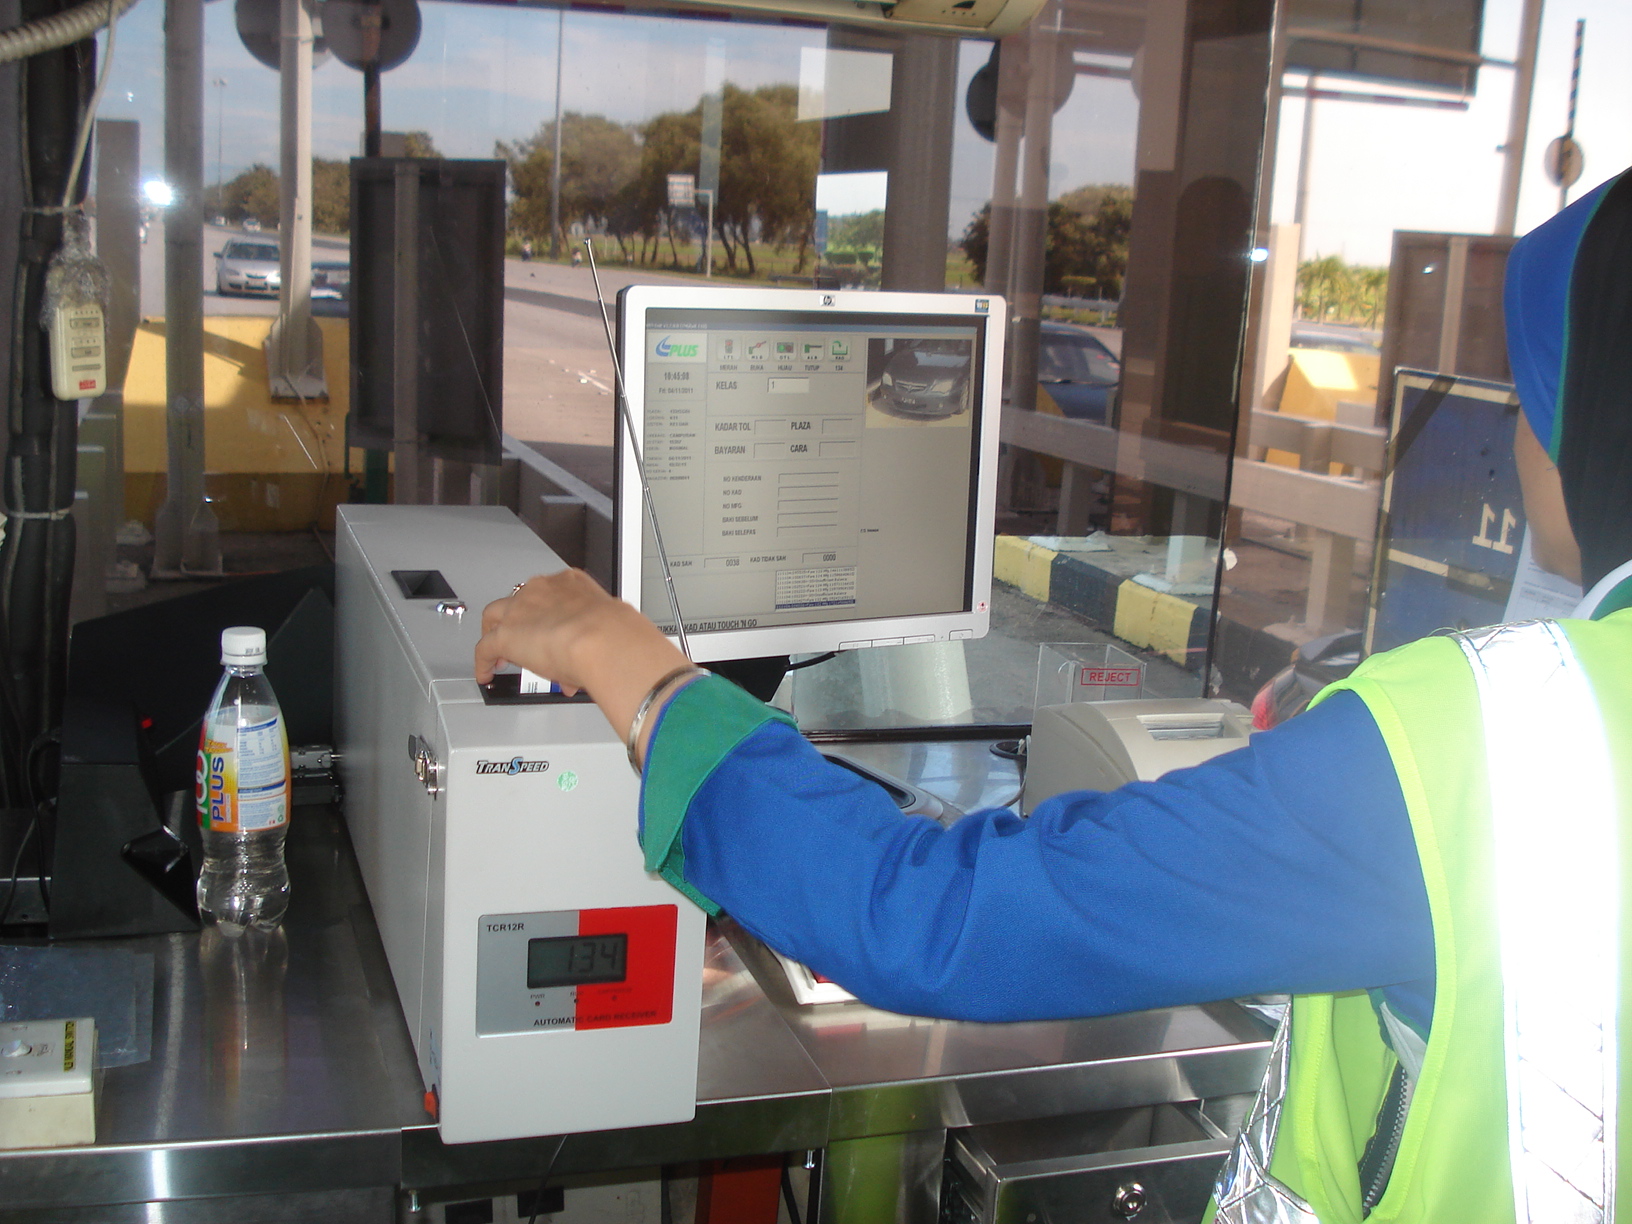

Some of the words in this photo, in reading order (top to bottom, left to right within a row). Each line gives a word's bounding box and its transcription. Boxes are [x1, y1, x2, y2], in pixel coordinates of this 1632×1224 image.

[669, 344, 698, 356] PLUS
[716, 381, 737, 390] KELAS
[715, 422, 738, 431] KADAR
[739, 422, 751, 431] TOL
[790, 421, 811, 431] PLAZA
[714, 445, 746, 455] BAYARAN
[790, 444, 808, 453] CARA
[684, 624, 698, 632] KAD
[699, 622, 717, 631] ATAU
[717, 620, 739, 629] TOUCH
[747, 619, 758, 627] GO
[1089, 671, 1132, 682] REJECT
[212, 756, 225, 822] PLUS
[486, 923, 525, 932] TCR12R
[567, 940, 620, 973] 134
[533, 1016, 583, 1027] AUTOMATIC
[586, 1013, 612, 1023] CARD
[614, 1010, 657, 1020] RECEIVER
